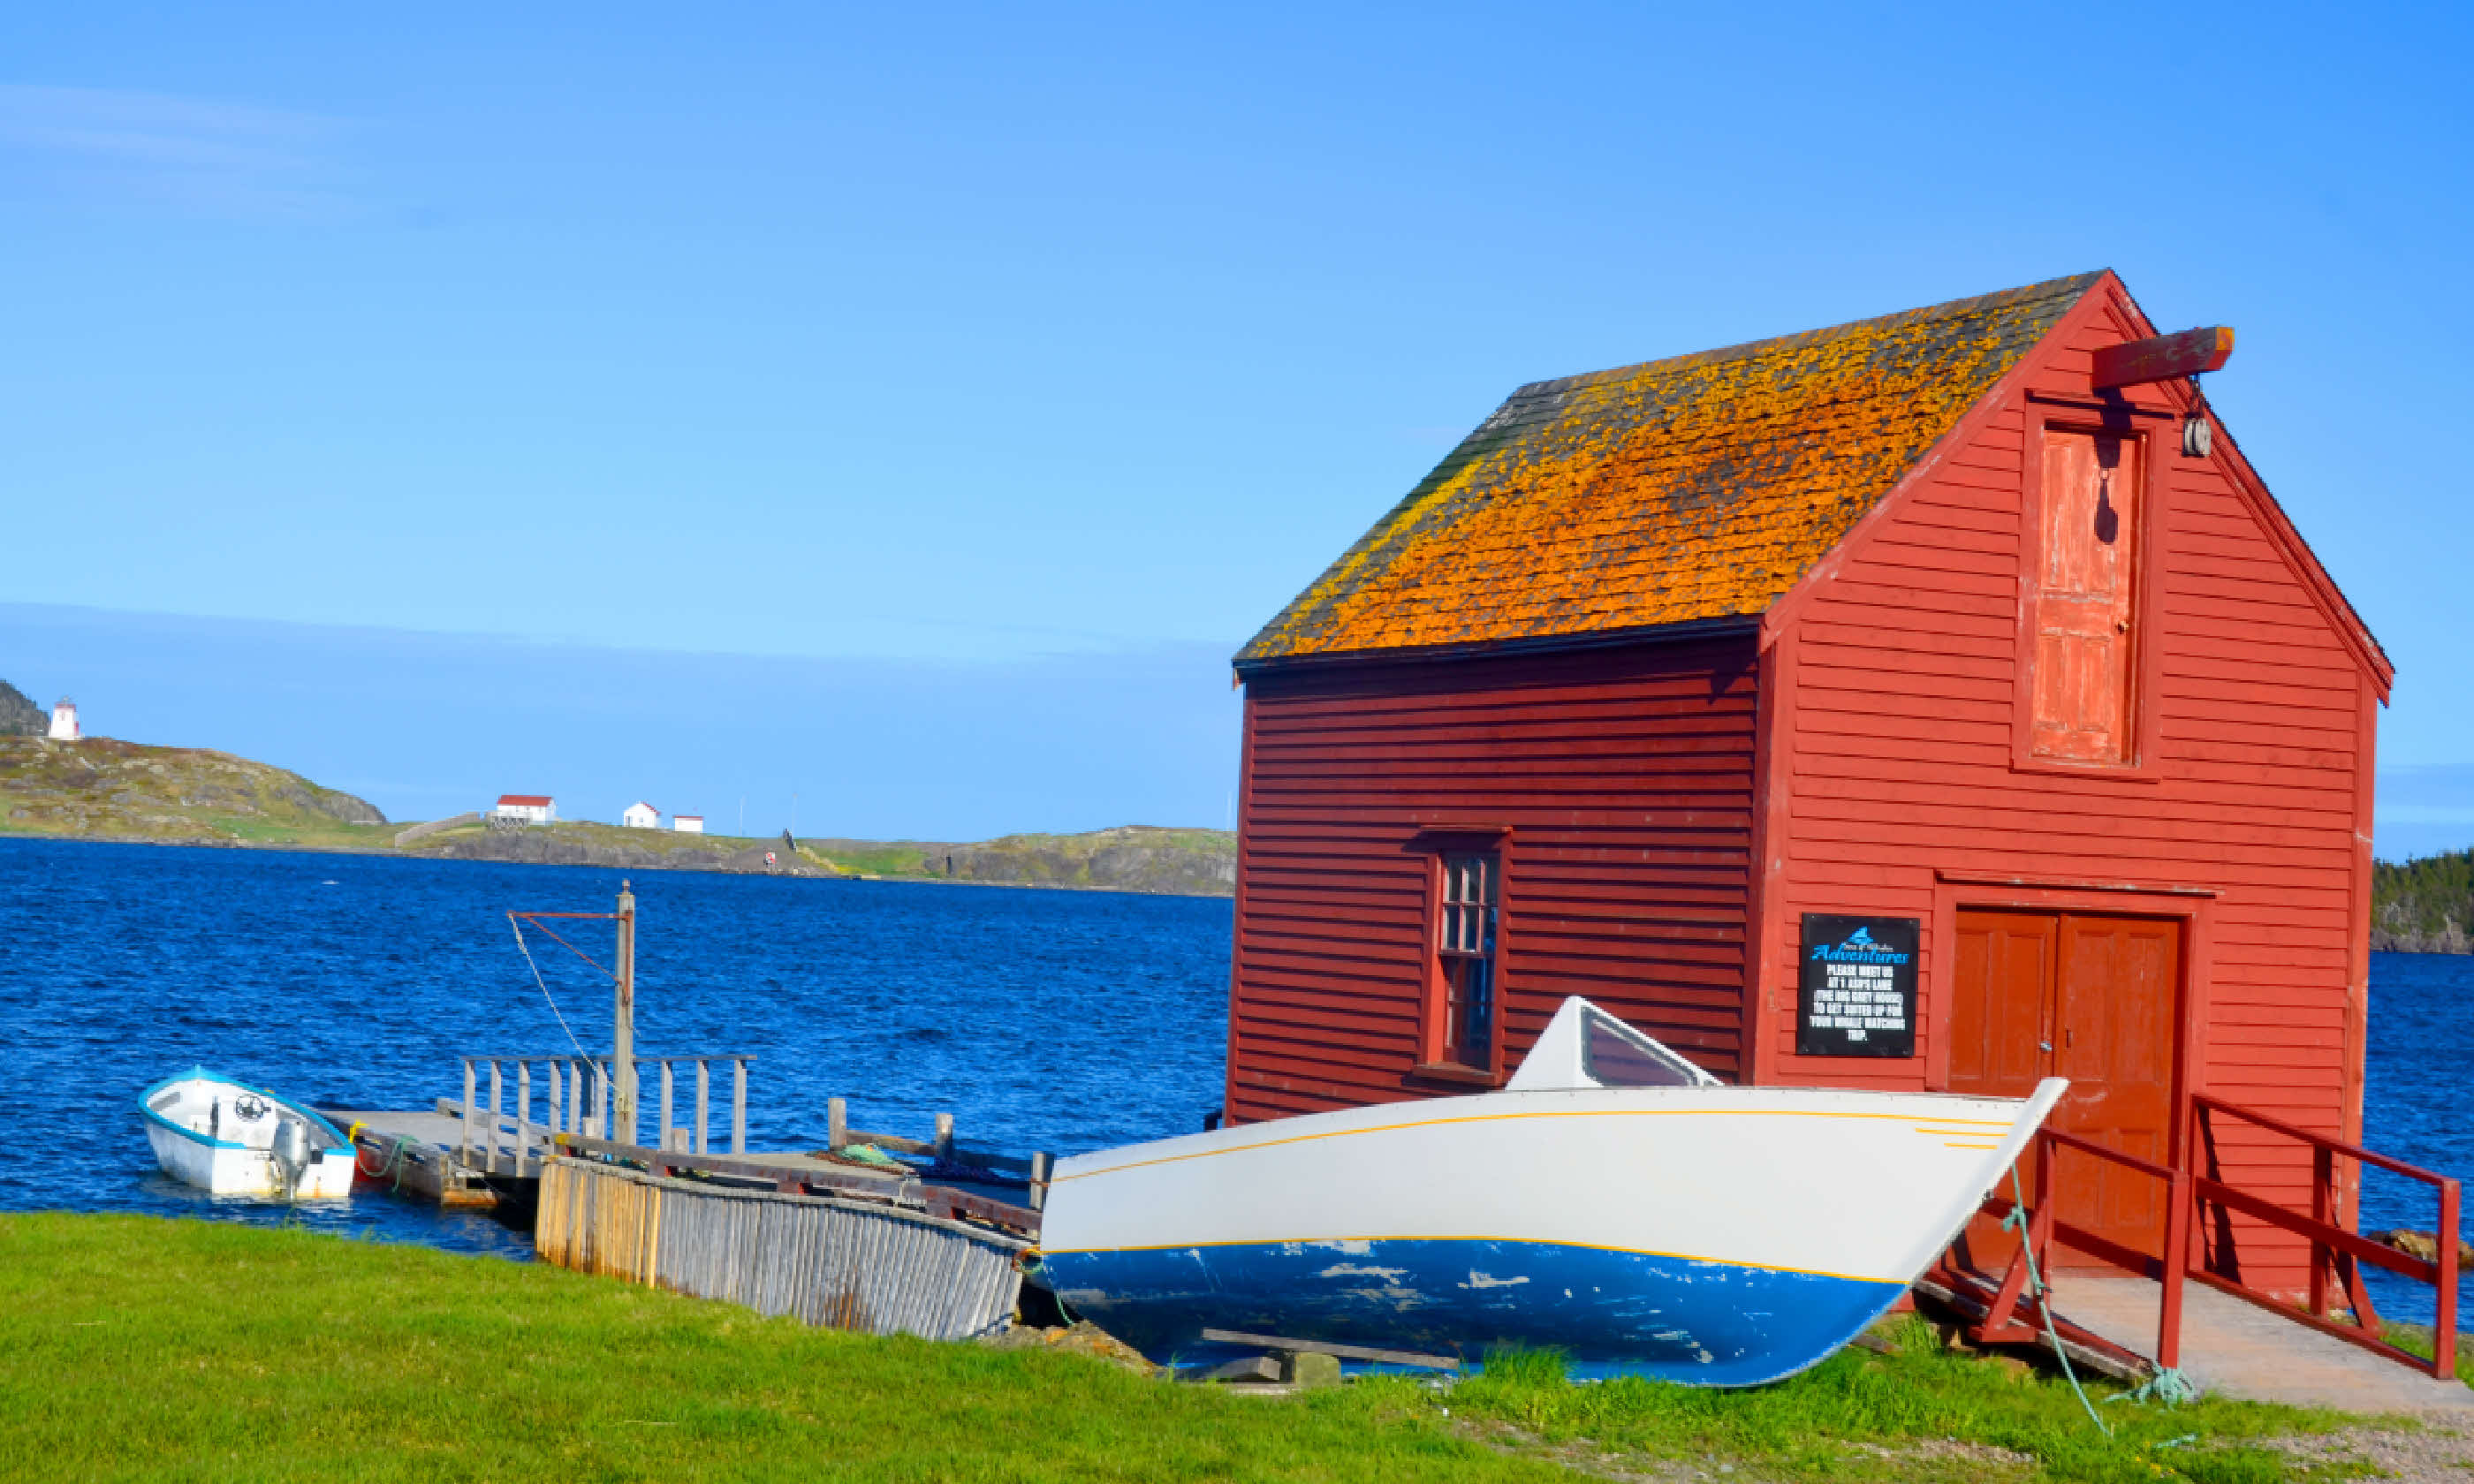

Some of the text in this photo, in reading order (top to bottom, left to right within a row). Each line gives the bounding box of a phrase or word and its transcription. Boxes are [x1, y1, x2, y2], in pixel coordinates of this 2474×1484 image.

[1810, 943, 1909, 965] Adventures
[1826, 964, 1893, 978] PLEASE MEET US
[1827, 977, 1839, 988] AT
[1834, 990, 1851, 1002] BIG
[1814, 1003, 1825, 1014] TO
[1873, 1005, 1886, 1017] UP
[1810, 1015, 1906, 1031] YOUR WHALE WATCHING
